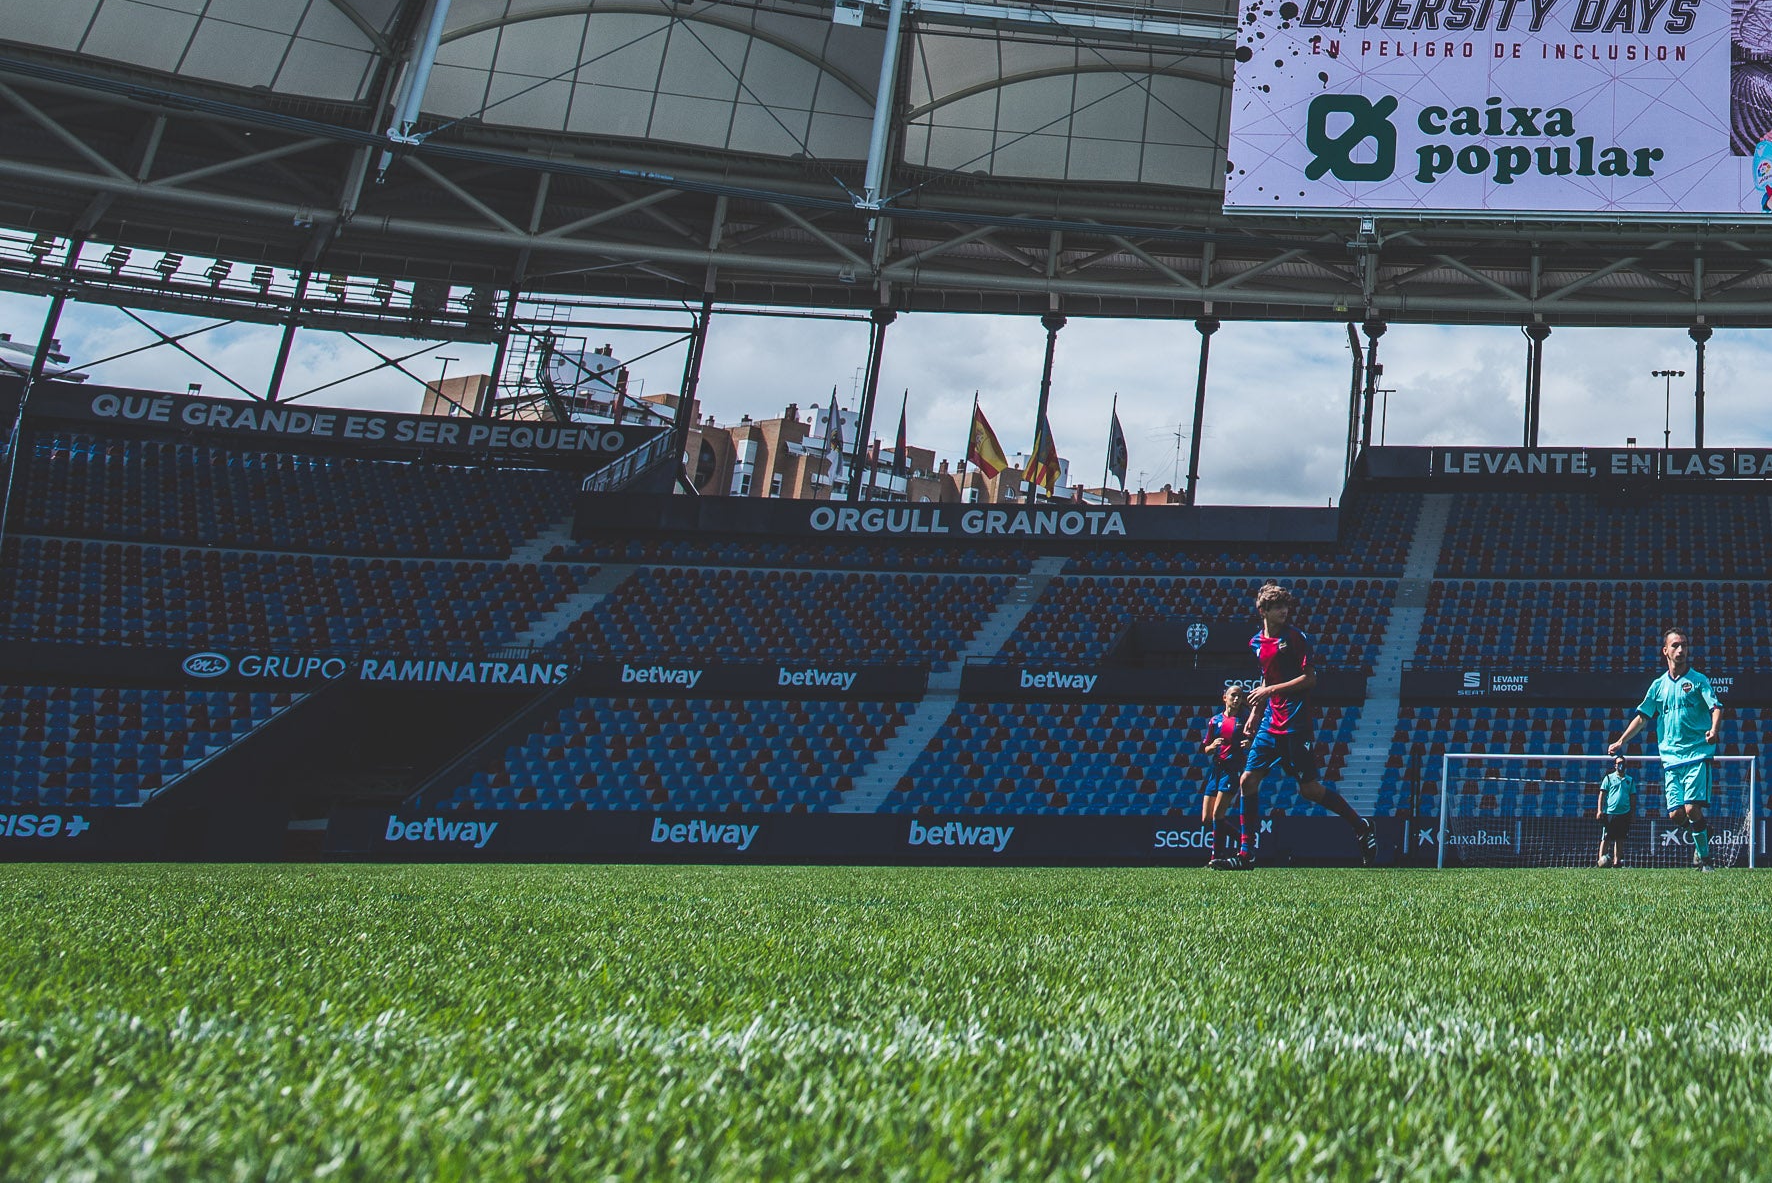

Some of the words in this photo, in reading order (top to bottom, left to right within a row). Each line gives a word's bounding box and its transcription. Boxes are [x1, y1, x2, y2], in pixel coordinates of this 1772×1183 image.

[1311, 40, 1341, 58] EN
[1361, 41, 1474, 59] PELIGRO
[1494, 43, 1523, 60] DE
[1542, 43, 1688, 62] INCLUSION
[1417, 96, 1576, 138] caixa
[1415, 136, 1665, 185] popular
[91, 393, 175, 422] QUÉ
[181, 402, 336, 436] GRANDE
[343, 416, 386, 440] ES
[394, 419, 460, 444] SER
[467, 424, 625, 452] PEQUEÑO
[1443, 452, 1597, 478] LEVANTE,
[1611, 453, 1650, 474] EN
[1666, 454, 1726, 475] LAS
[809, 506, 949, 533] ORGULL
[961, 510, 1127, 536] GRANOTA
[238, 655, 347, 679] GRUPO
[359, 659, 569, 684] RAMINATRANS
[621, 664, 702, 689] betway
[778, 667, 857, 691] betway
[1020, 670, 1098, 693] betway
[1493, 675, 1529, 683] LEVANTE
[1492, 684, 1524, 692] MOTOR
[386, 815, 498, 848] betway
[651, 817, 760, 851] betway
[908, 820, 1015, 854] betway
